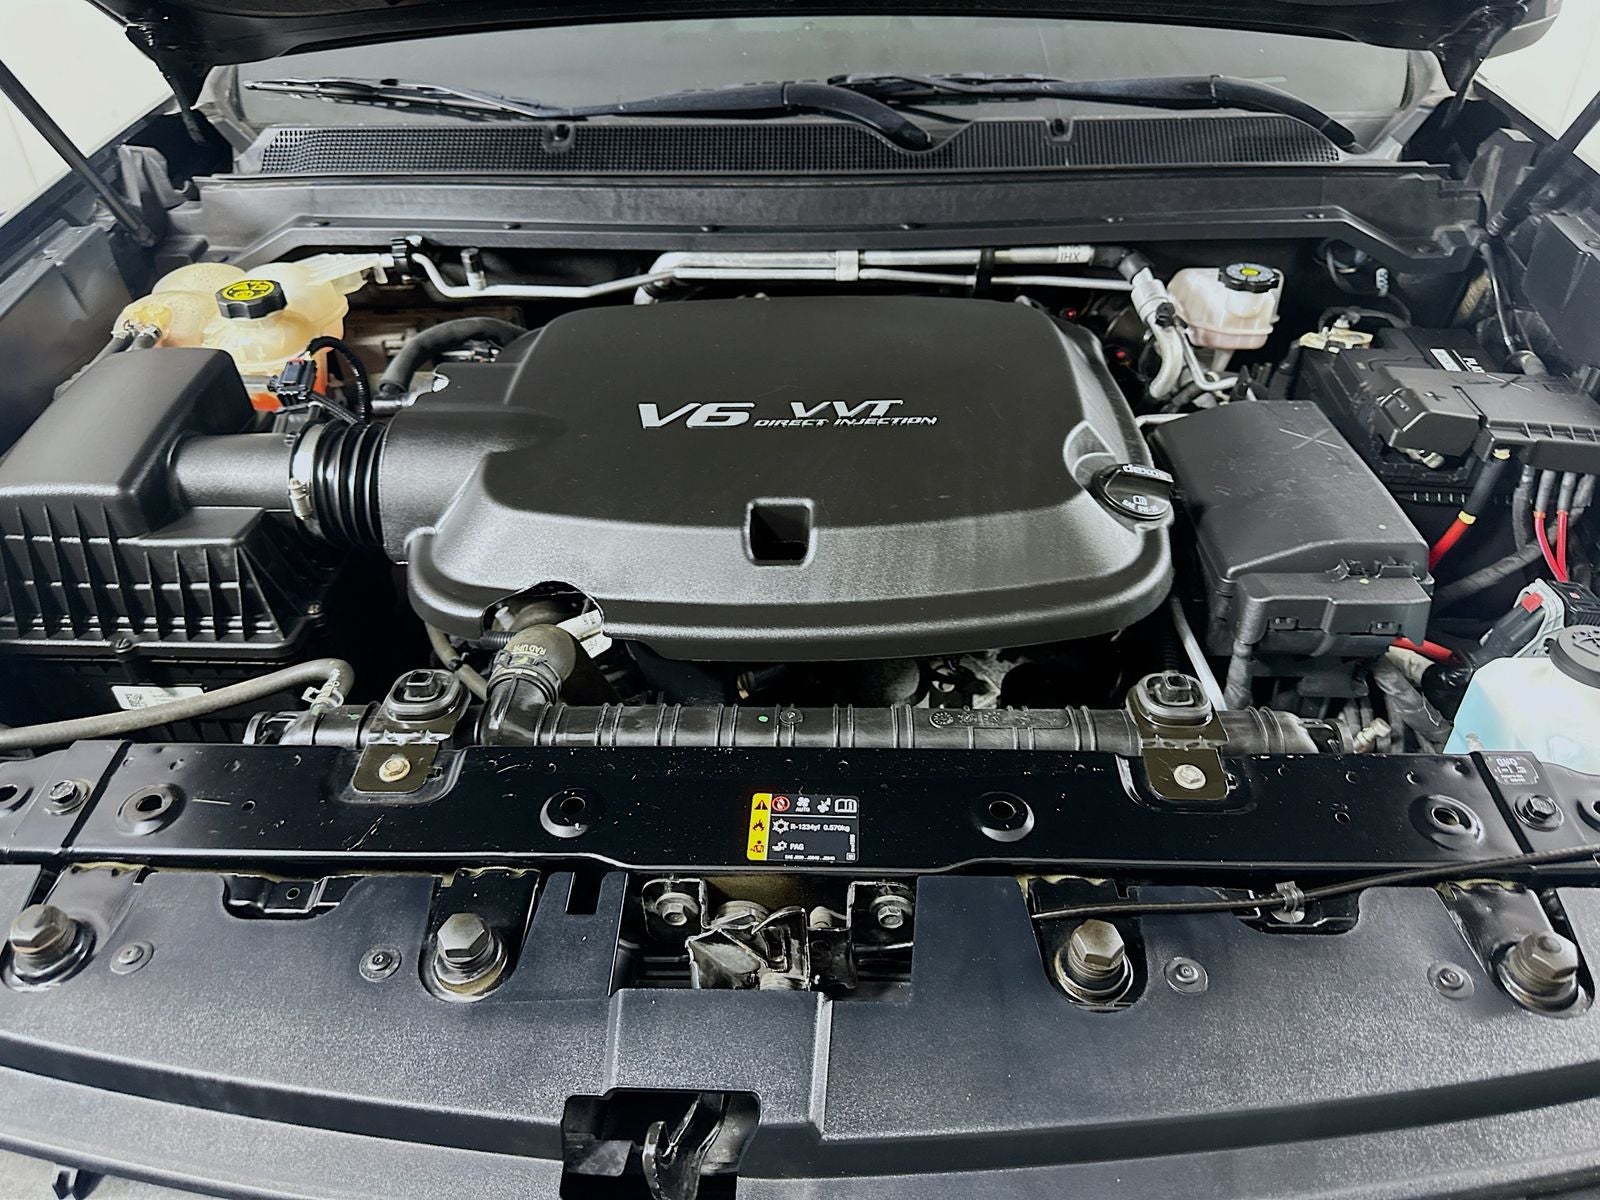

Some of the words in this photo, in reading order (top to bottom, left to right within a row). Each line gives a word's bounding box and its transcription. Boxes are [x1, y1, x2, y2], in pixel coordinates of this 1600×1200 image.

[638, 402, 756, 429] V6
[790, 399, 904, 419] VVT
[753, 419, 830, 428] DIRECT
[833, 416, 938, 427] INJECTION
